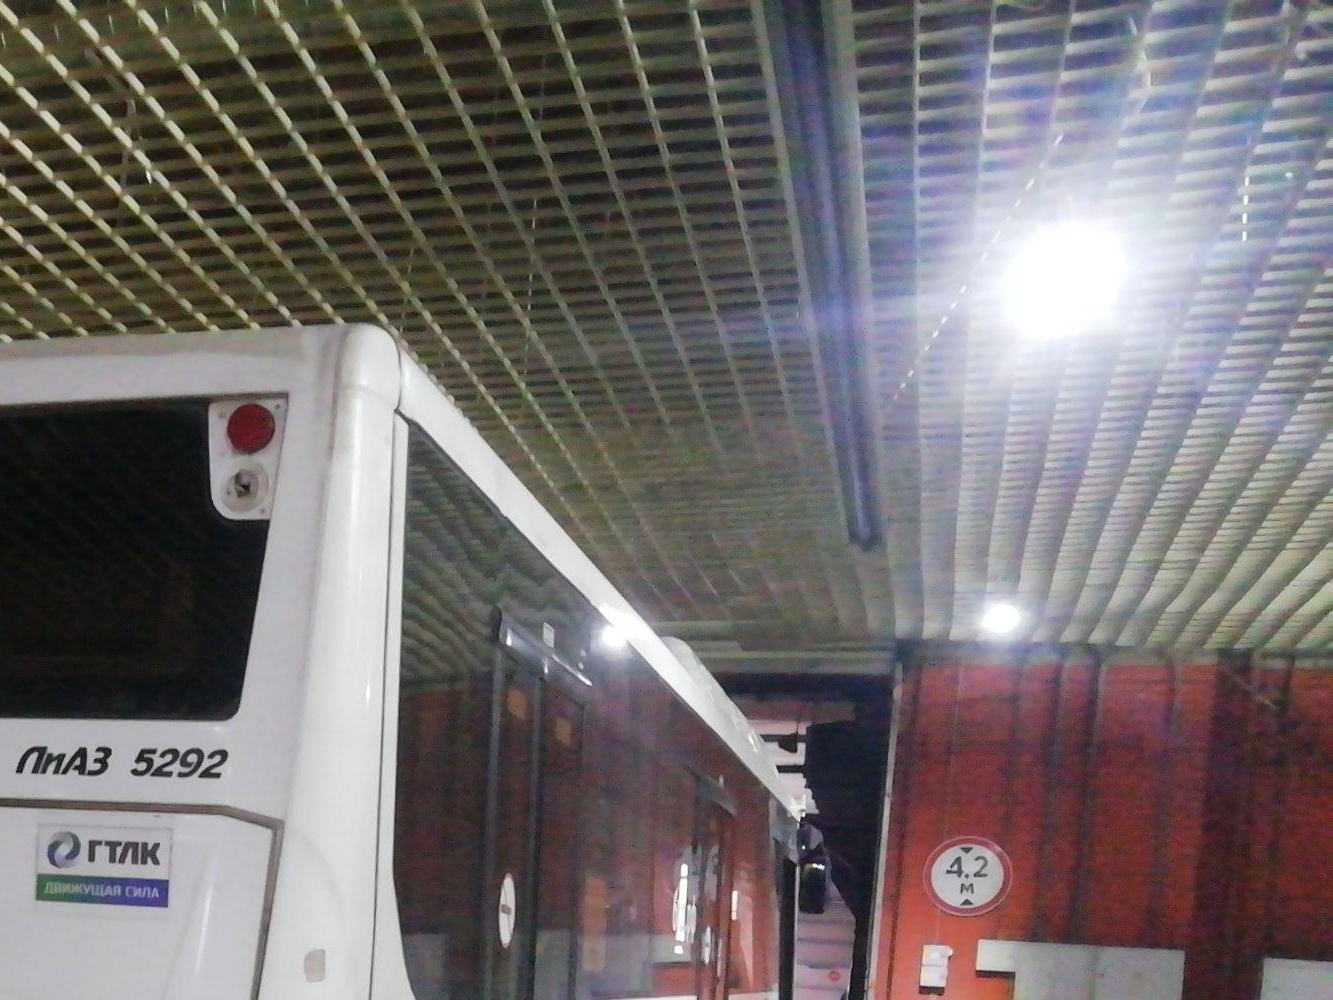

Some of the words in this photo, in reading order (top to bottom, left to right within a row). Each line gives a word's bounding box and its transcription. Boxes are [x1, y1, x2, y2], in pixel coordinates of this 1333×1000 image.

[130, 747, 229, 779] 5292
[87, 840, 161, 866] ГТЛК
[43, 881, 122, 898] ДВИЖУЩАЯ
[125, 885, 160, 899] СИЛА
